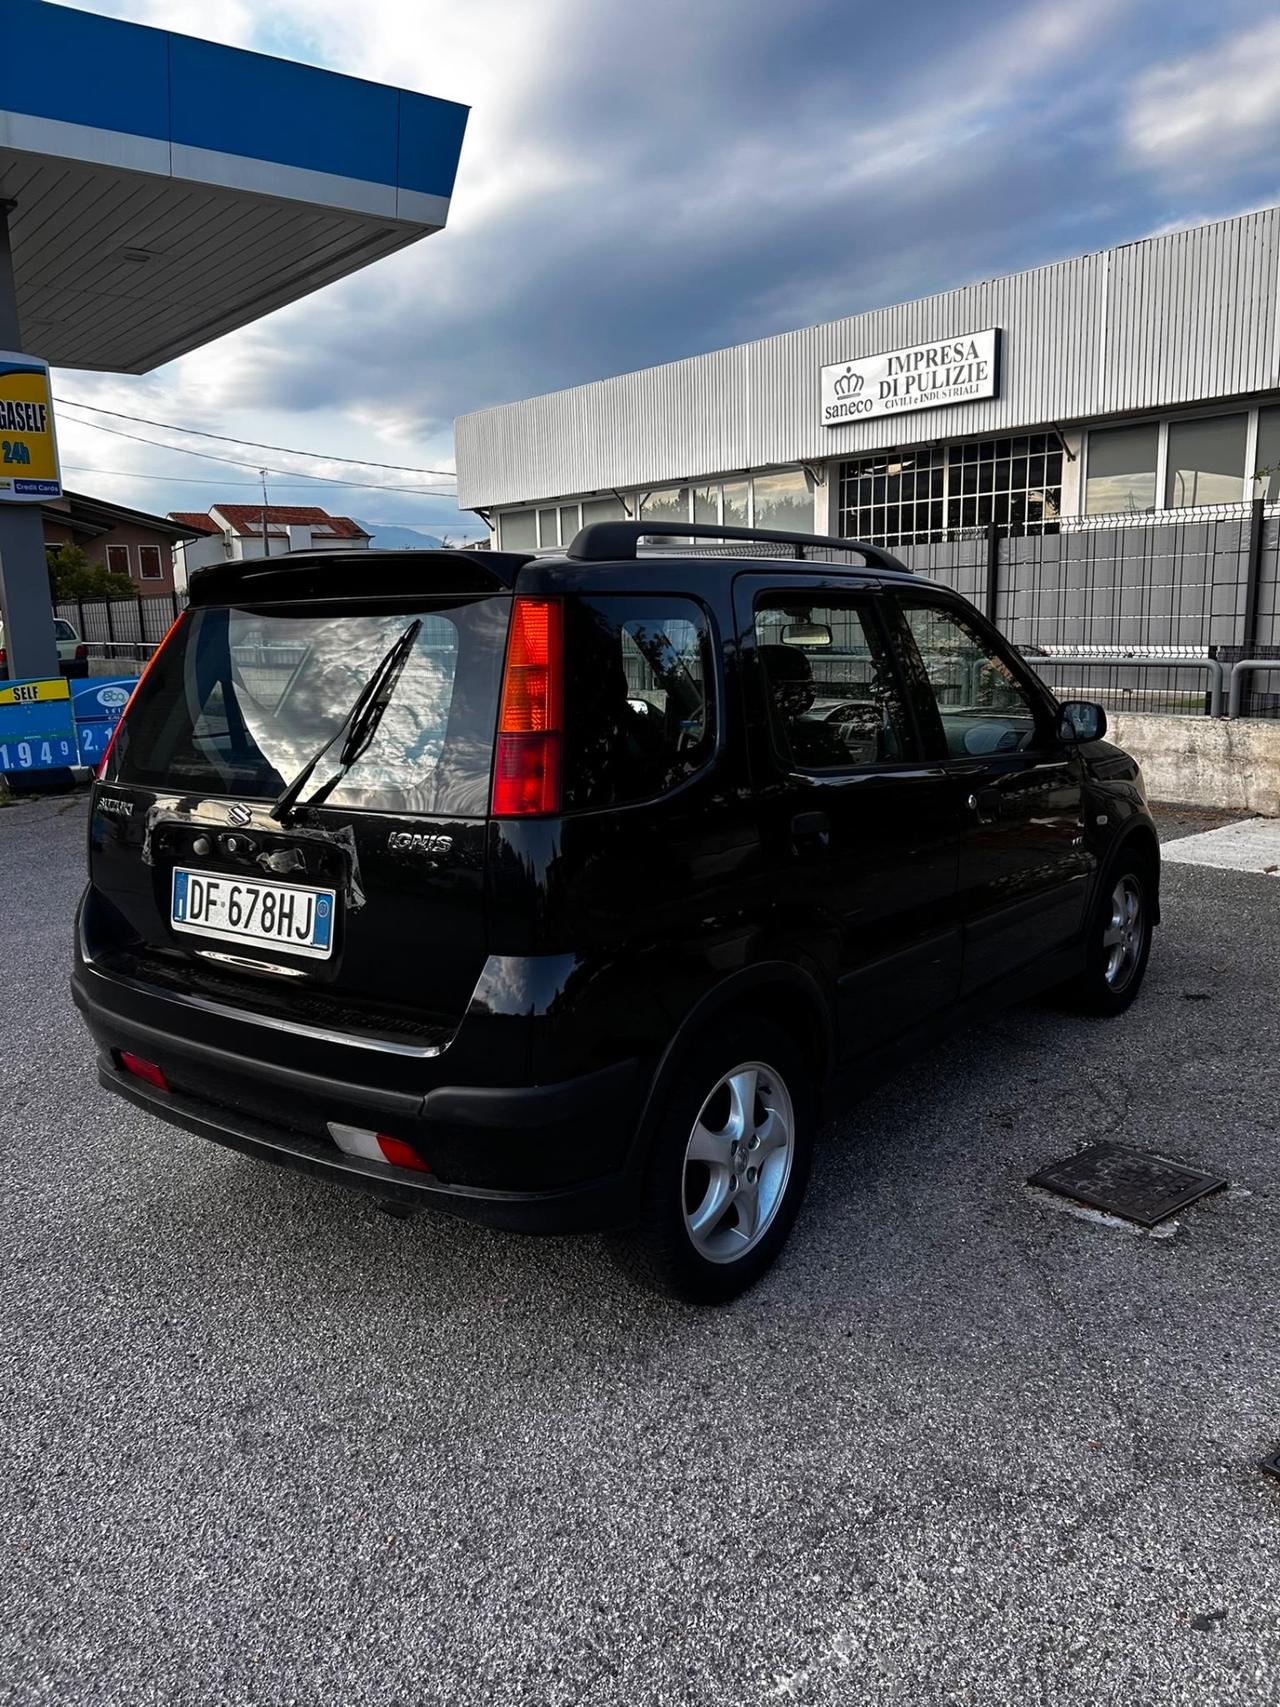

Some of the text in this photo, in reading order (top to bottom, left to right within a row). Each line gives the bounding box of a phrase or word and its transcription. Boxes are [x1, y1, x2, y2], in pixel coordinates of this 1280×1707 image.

[887, 340, 979, 377] IMPRESA
[879, 360, 988, 400] DI PULIZIE
[884, 396, 912, 409] CIVILI
[920, 383, 979, 403] INDUSTRIALI
[0, 400, 47, 433] GASELF
[825, 398, 873, 420] saneco
[2, 440, 31, 465] 24h
[16, 483, 37, 491] Credit
[38, 484, 59, 492] Cards
[12, 686, 39, 701] SELF
[387, 831, 453, 852] IGNIS
[190, 879, 220, 922] DF
[228, 885, 313, 940] 678HJ
